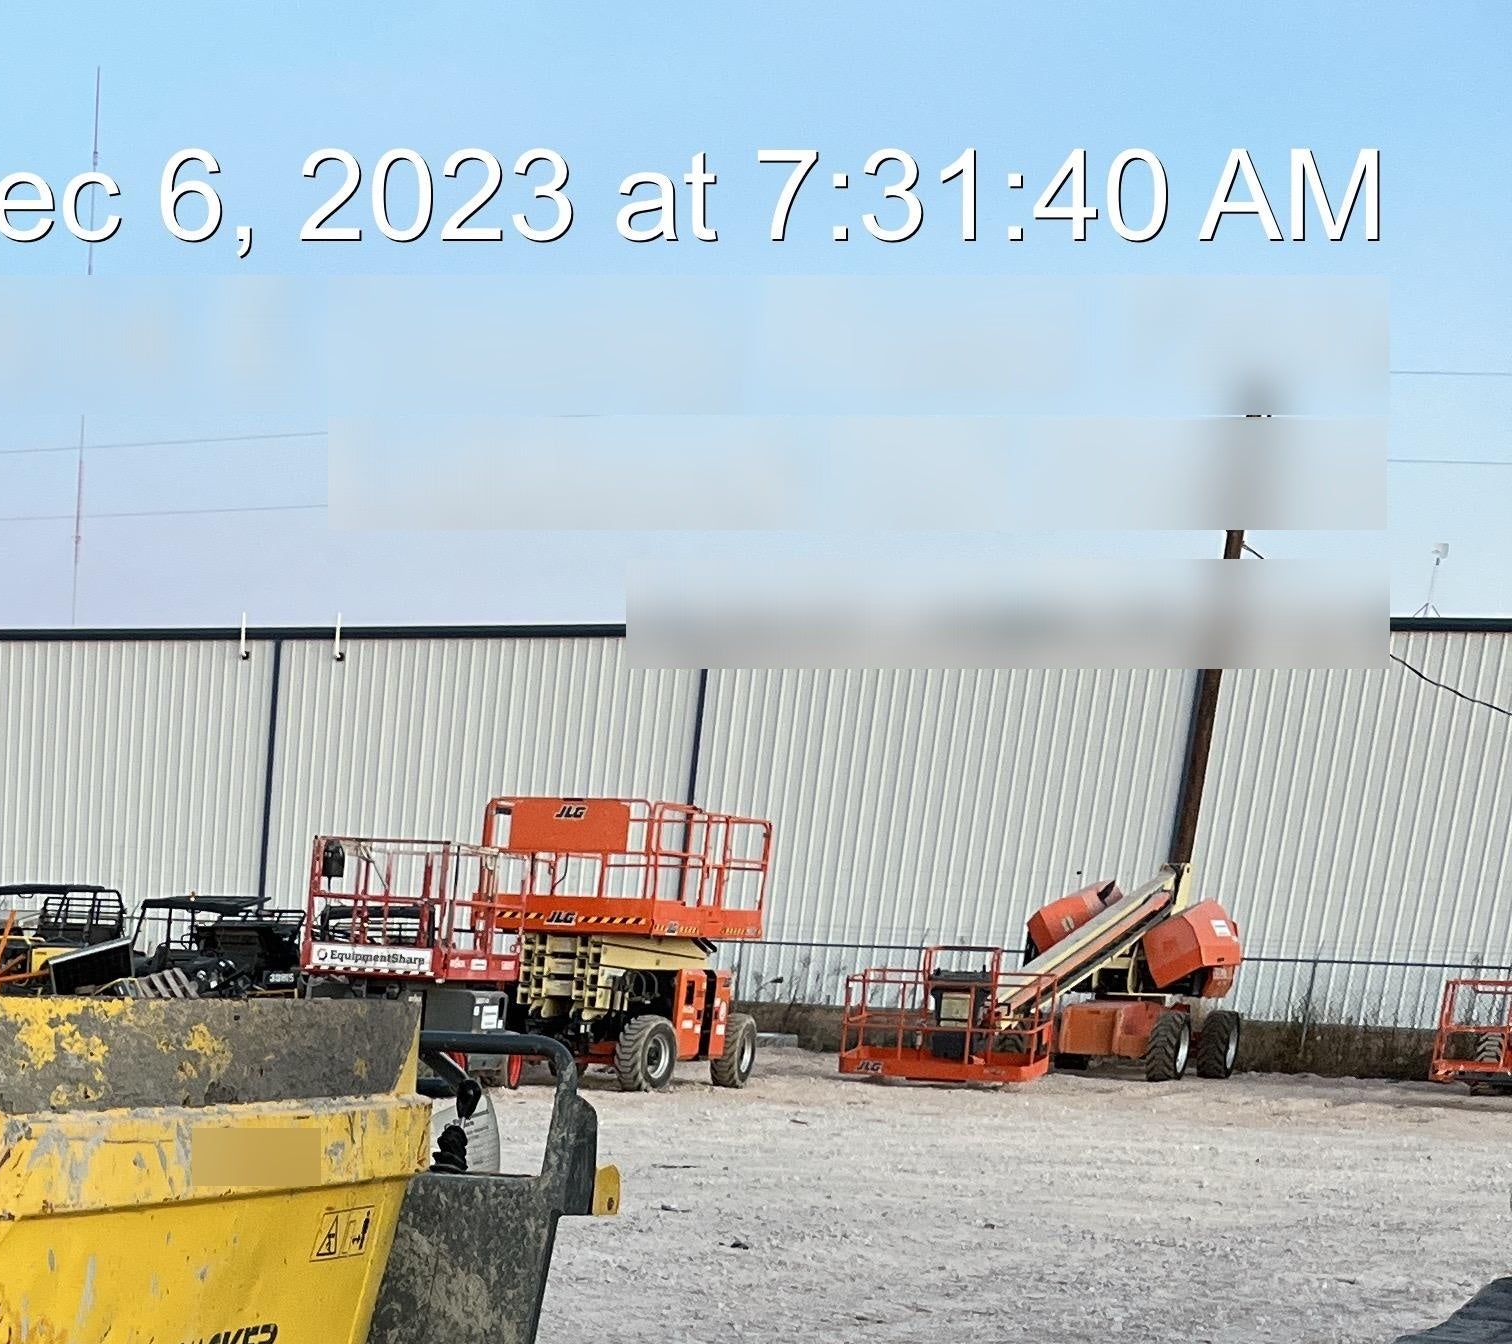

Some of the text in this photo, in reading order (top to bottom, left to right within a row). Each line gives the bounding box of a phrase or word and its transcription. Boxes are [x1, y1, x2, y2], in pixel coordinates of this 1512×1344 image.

[555, 805, 587, 819] JLG
[545, 911, 577, 925] JLG
[330, 949, 425, 966] EquipmentShare
[857, 1060, 883, 1073] JLG
